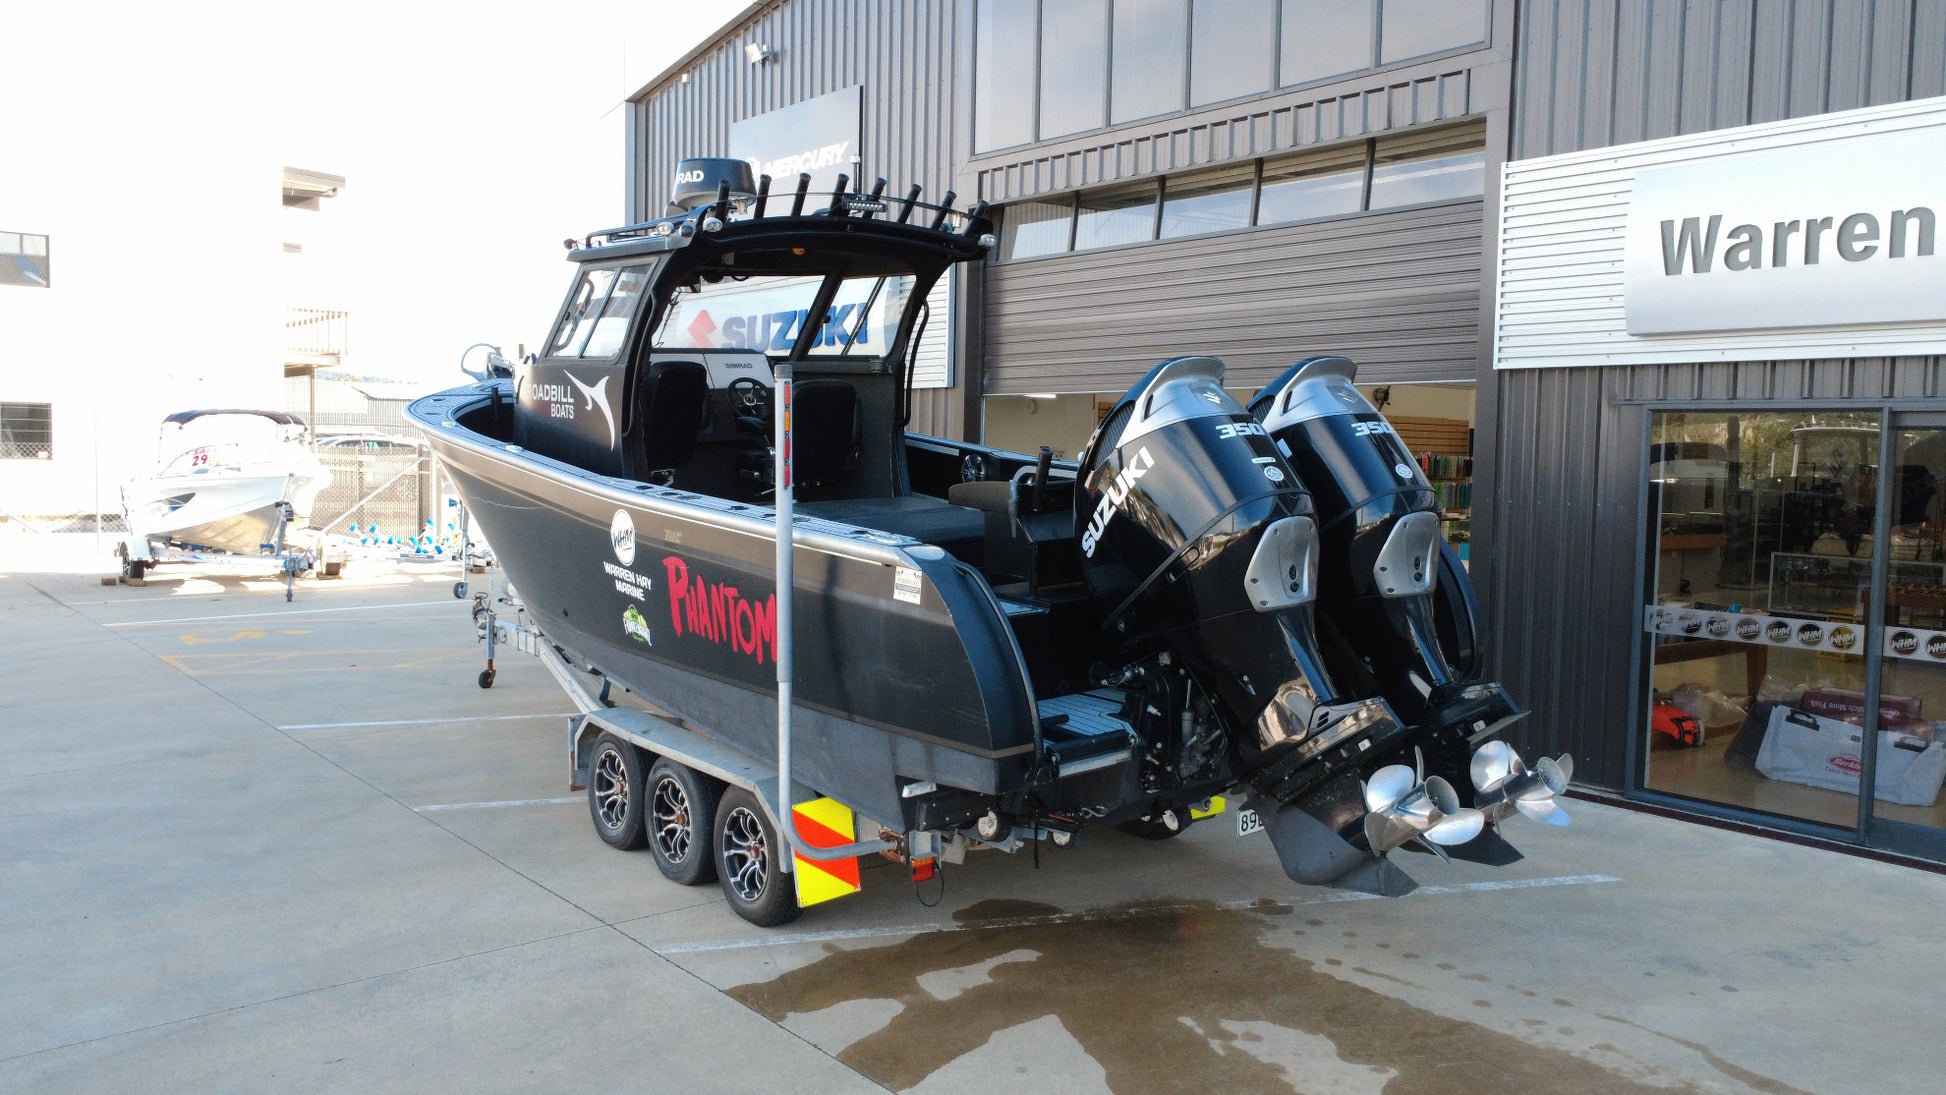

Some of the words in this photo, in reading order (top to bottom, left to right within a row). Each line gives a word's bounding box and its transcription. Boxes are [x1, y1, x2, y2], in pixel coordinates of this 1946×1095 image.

[763, 141, 849, 180] MERCURY
[1660, 207, 1936, 276] Warren
[550, 403, 575, 420] BOATS
[1216, 423, 1265, 440] 350
[1351, 422, 1394, 437] 350
[1081, 446, 1155, 558] SUZUKI
[603, 561, 635, 584] WARREN
[635, 573, 651, 590] HAY
[615, 580, 645, 601] MARINE
[662, 556, 777, 665] PHANTOM
[1241, 811, 1264, 832] 89
